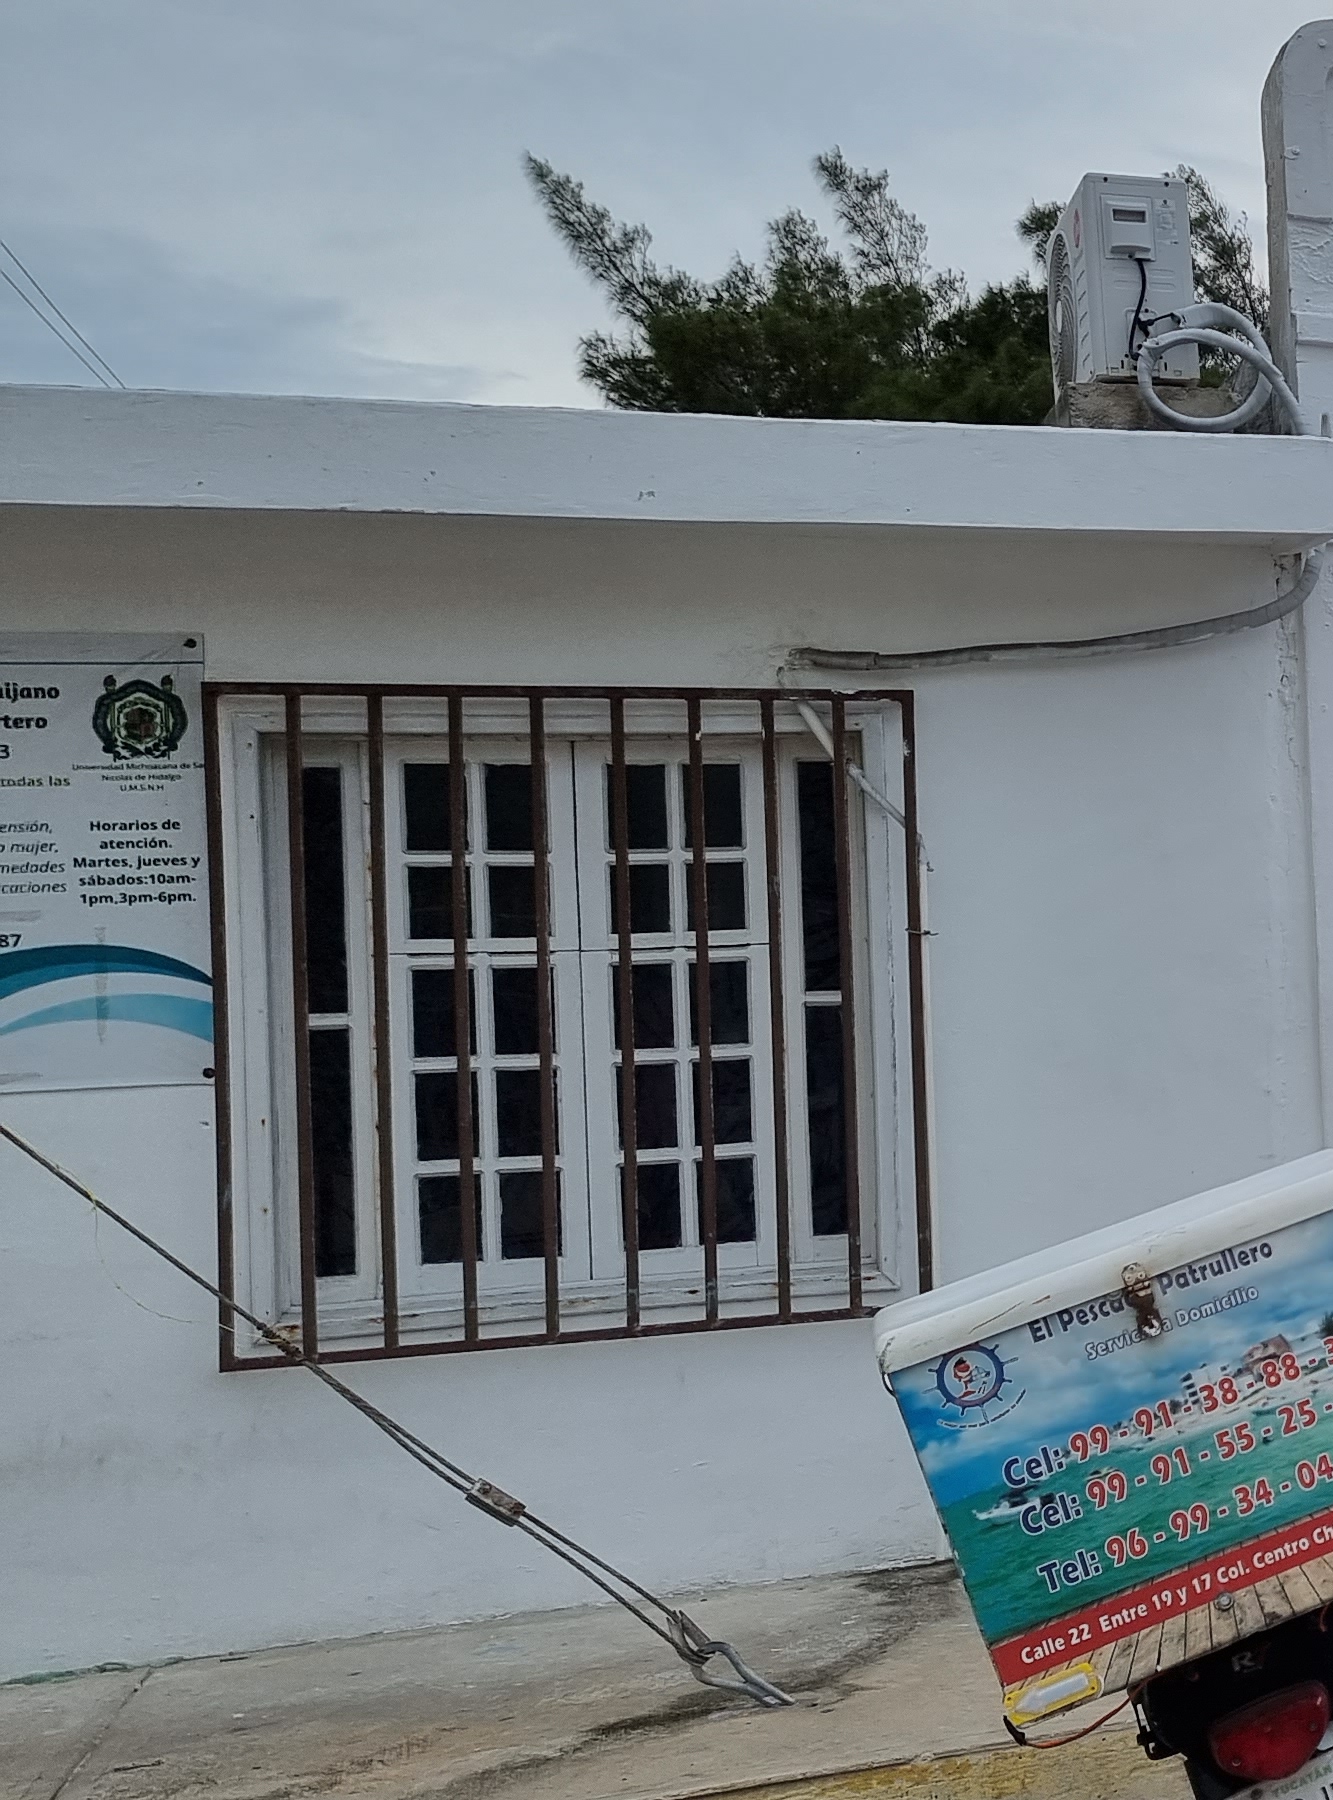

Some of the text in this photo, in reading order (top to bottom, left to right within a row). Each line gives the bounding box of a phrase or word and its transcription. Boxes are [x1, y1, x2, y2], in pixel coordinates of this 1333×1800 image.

[0, 715, 48, 729] tero
[50, 776, 71, 787] las
[90, 819, 181, 831] Horarios de
[100, 837, 172, 849] atención.
[136, 856, 187, 870] jueves
[190, 857, 201, 868] y
[1028, 1241, 1274, 1344] El Patrullero
[1176, 1286, 1259, 1327] Domicilio
[1003, 1446, 1066, 1488] Cel:
[1069, 1425, 1110, 1461] 99
[1133, 1400, 1174, 1437] 91
[1200, 1377, 1238, 1414] 38
[1260, 1353, 1301, 1389] 88
[1021, 1492, 1083, 1535] Cel:
[1086, 1471, 1127, 1510] 99
[1151, 1447, 1191, 1484] 91
[1215, 1423, 1255, 1460] 55
[1277, 1399, 1317, 1436] 25
[1037, 1549, 1102, 1593] Tel:
[1105, 1528, 1148, 1566] 96
[1169, 1504, 1210, 1541] 99
[1233, 1480, 1274, 1516] 34
[1020, 1636, 1066, 1664] Calle
[1068, 1623, 1092, 1645] 22
[1098, 1604, 1148, 1632] Entre
[1152, 1591, 1174, 1612] 19
[1192, 1575, 1212, 1593] 17
[1216, 1561, 1250, 1585] Col.
[1252, 1537, 1310, 1567] Centro
